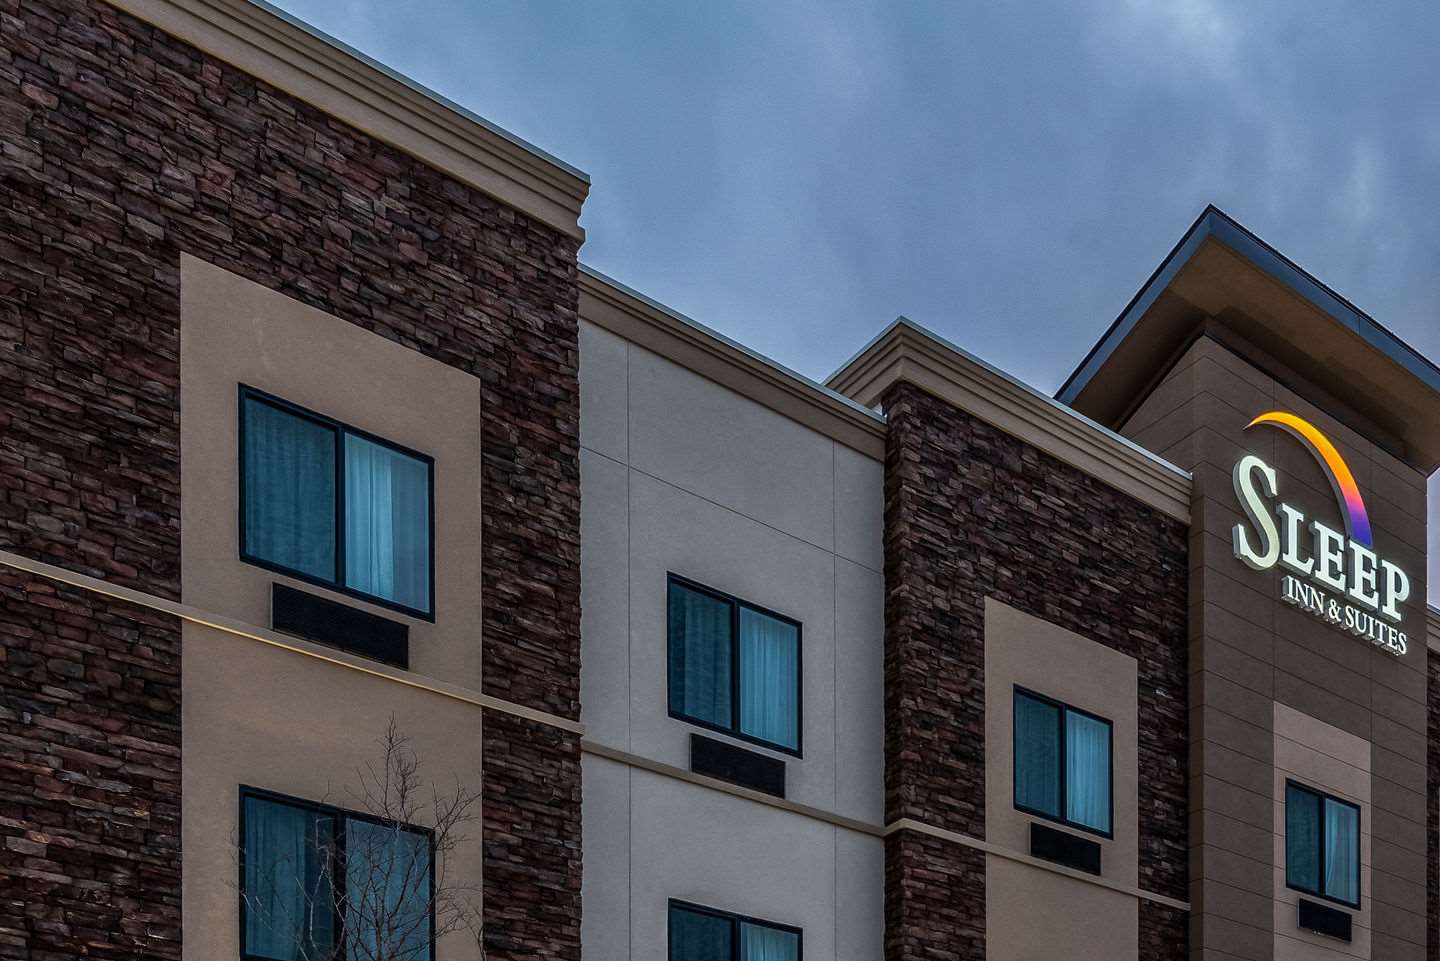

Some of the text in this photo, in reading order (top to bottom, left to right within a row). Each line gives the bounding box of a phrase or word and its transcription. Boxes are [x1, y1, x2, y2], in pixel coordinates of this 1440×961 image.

[1234, 455, 1410, 622] SLEEP
[1285, 575, 1408, 656] INN & SUITES
